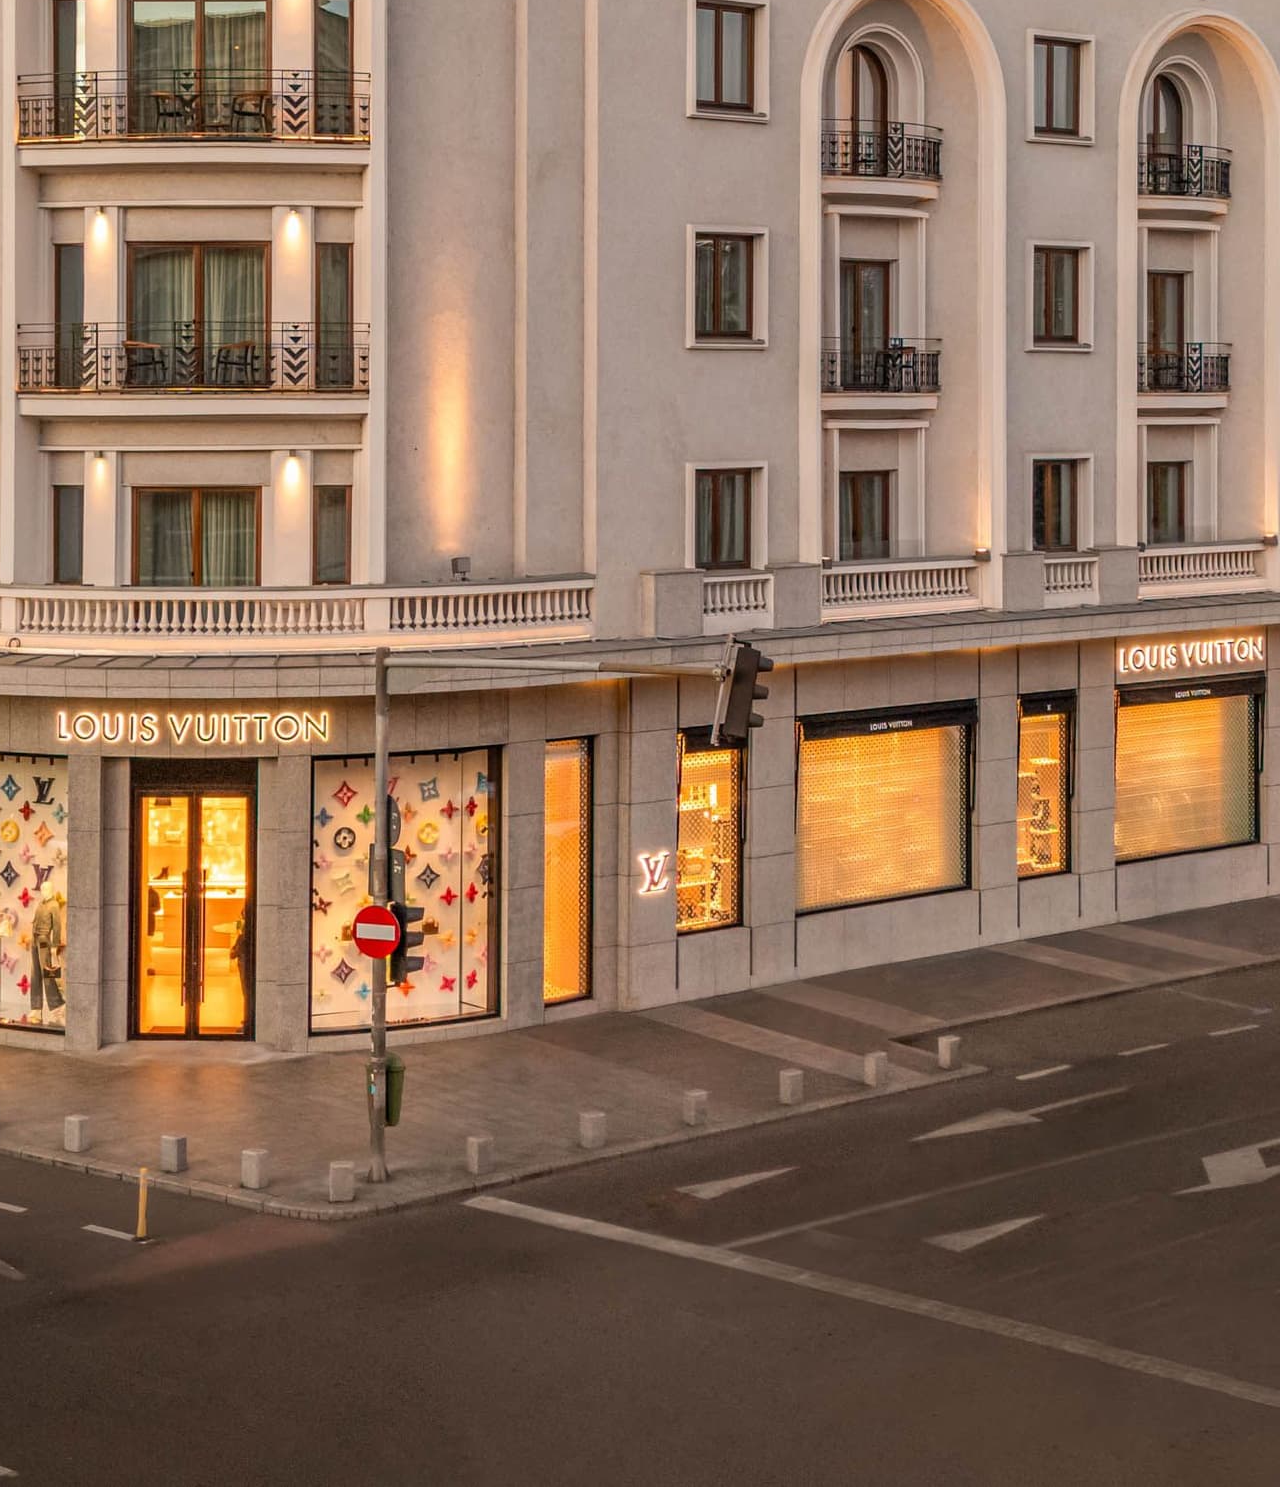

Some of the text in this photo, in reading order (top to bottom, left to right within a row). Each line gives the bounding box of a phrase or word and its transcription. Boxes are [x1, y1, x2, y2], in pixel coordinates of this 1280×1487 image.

[1120, 636, 1264, 673] LOUIS VUITTON
[56, 711, 329, 743] LOUIS VUITTON
[870, 721, 888, 731] LOUIS
